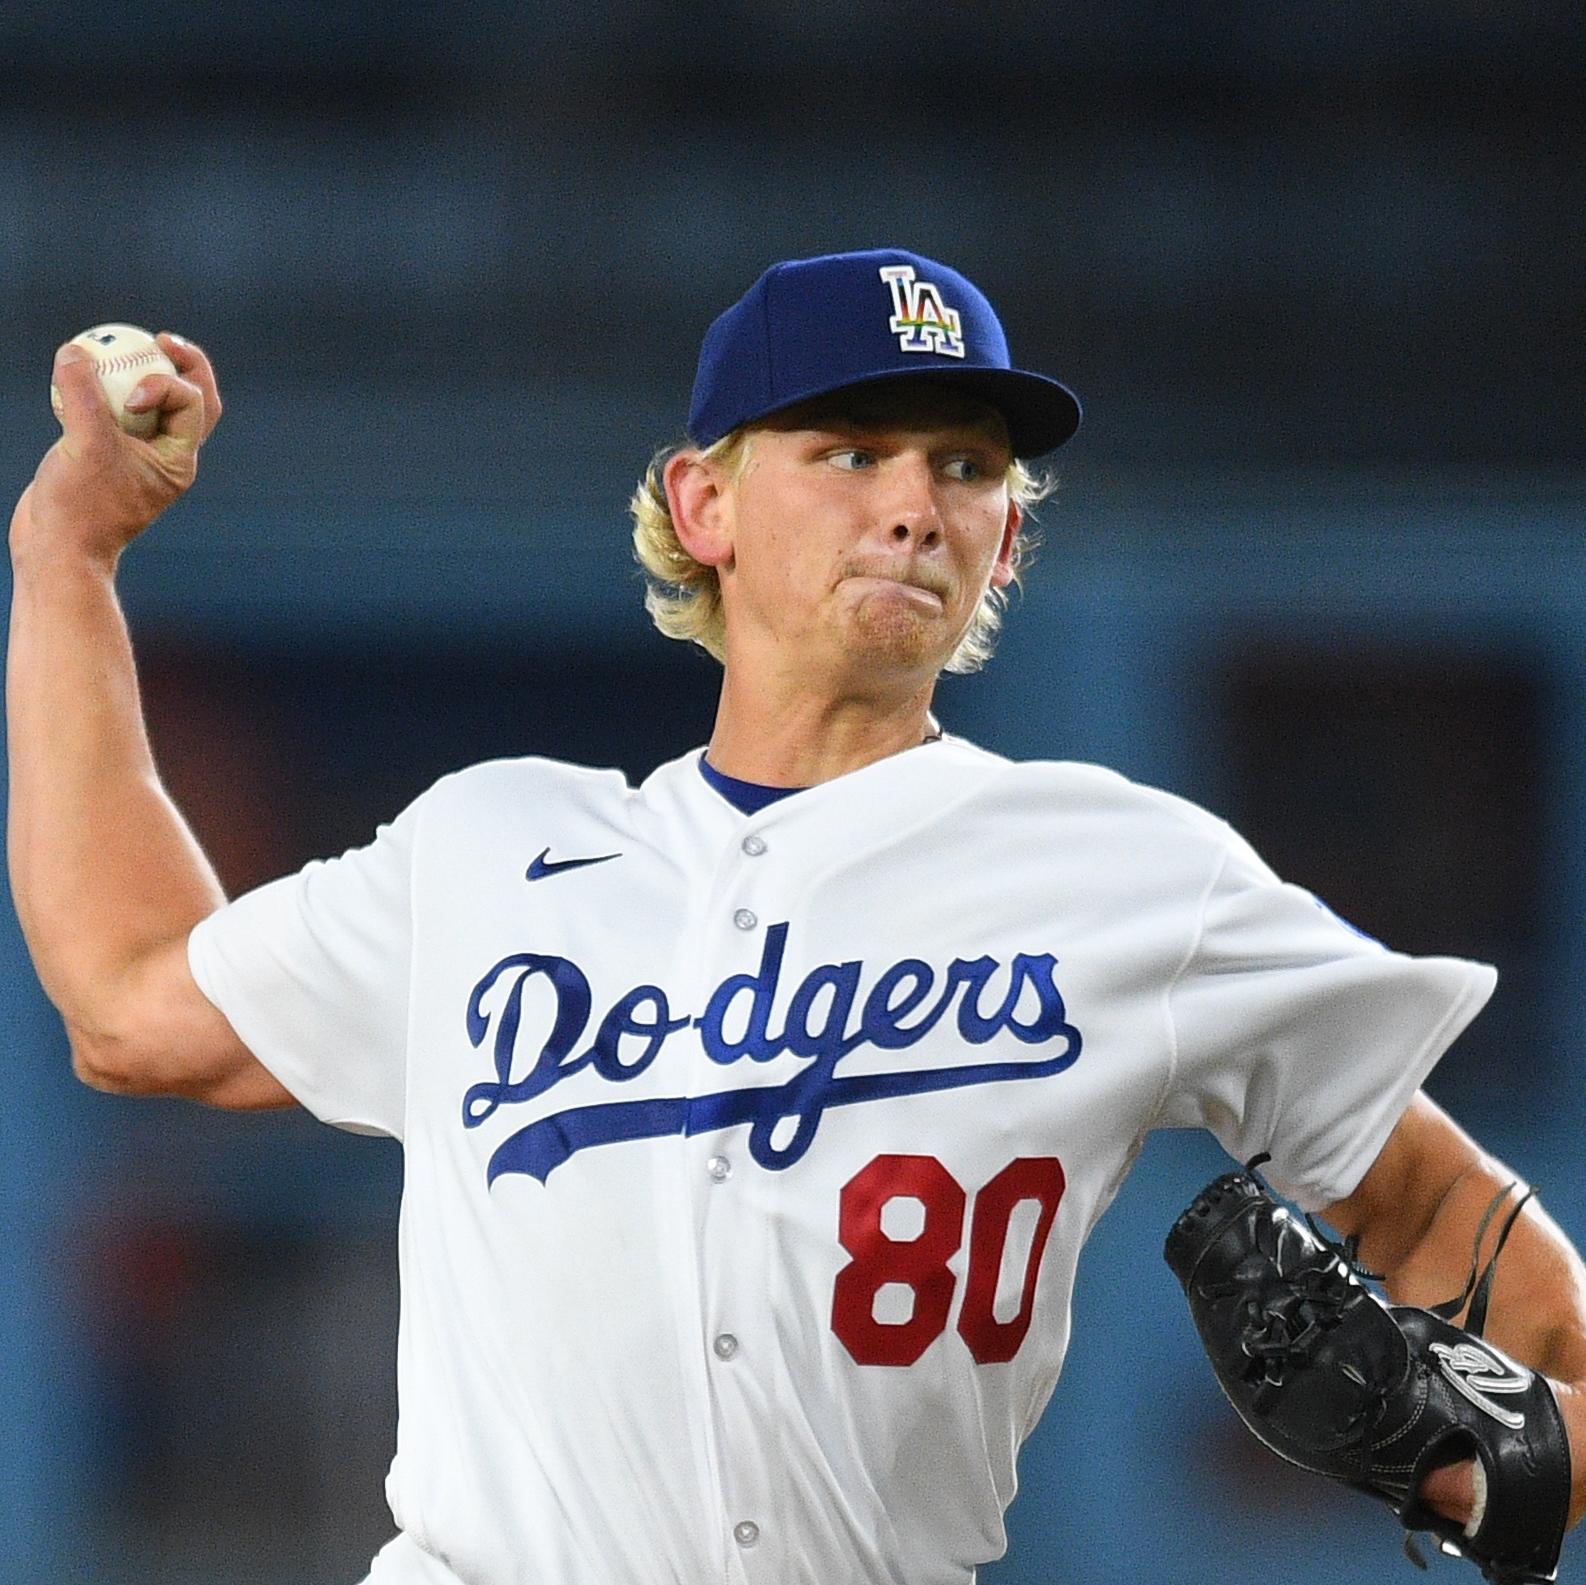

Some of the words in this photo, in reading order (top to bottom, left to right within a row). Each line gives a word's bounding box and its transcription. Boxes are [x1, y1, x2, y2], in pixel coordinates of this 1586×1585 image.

[879, 265, 965, 358] LA
[463, 922, 1082, 1172] Dodgers
[830, 1154, 1066, 1367] 80
